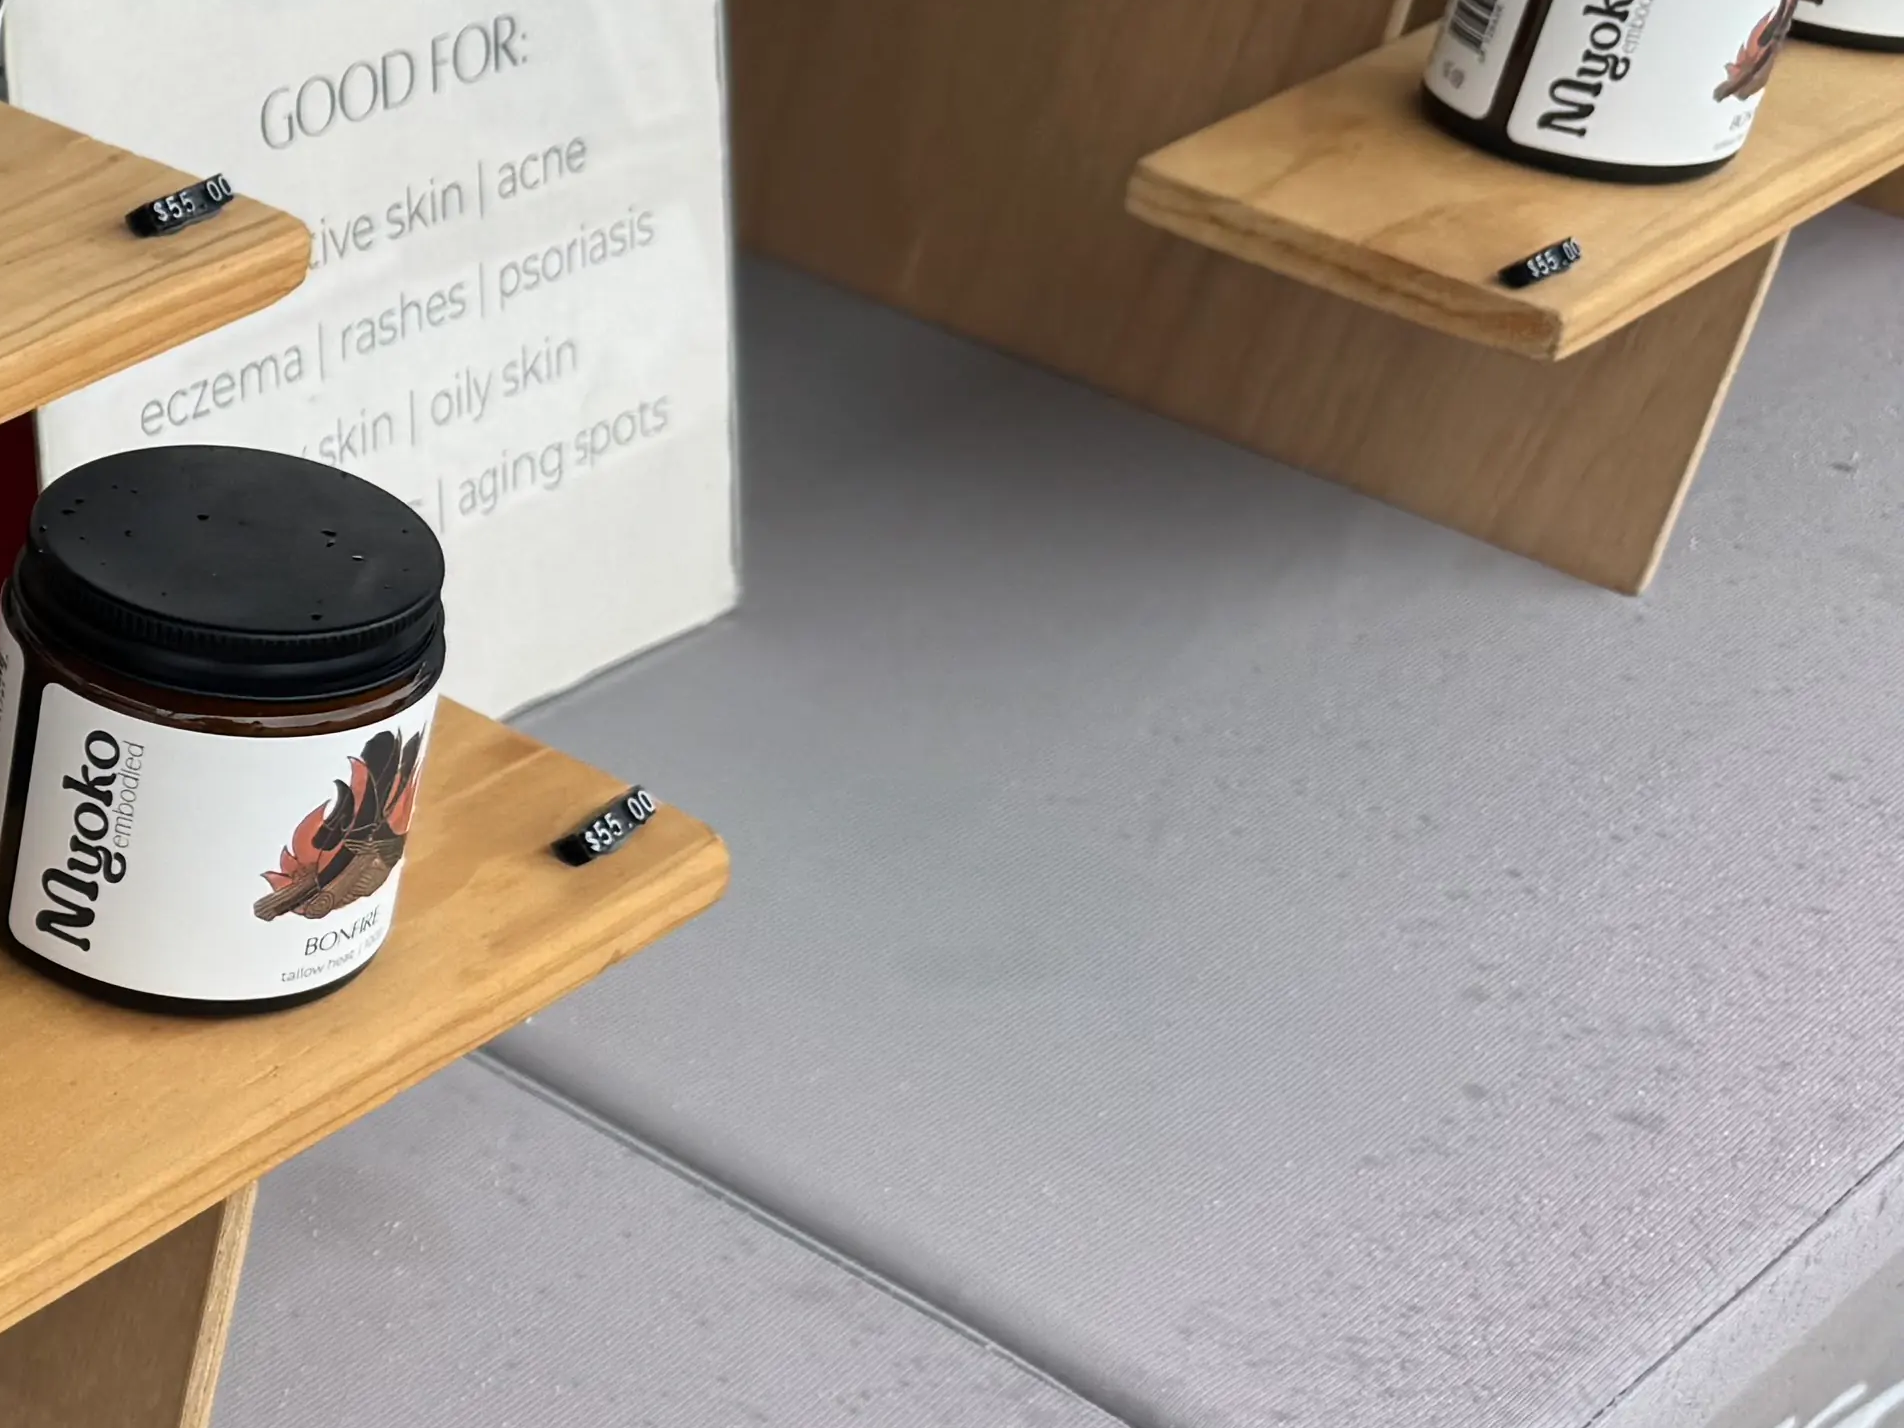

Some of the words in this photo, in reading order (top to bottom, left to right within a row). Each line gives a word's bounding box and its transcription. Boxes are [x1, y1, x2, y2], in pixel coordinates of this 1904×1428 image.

[260, 47, 415, 150] GOOD
[431, 13, 529, 95] FOR:
[386, 178, 465, 240] skin
[497, 136, 588, 200] acne
[140, 343, 304, 438] eczema
[339, 278, 467, 361] rashes
[498, 206, 656, 312] psoriasis
[318, 407, 394, 467] skin
[430, 367, 493, 428] oily
[502, 336, 579, 399] skin
[457, 440, 566, 516] aging
[574, 393, 671, 468] spots
[36, 729, 126, 952] Myoko
[112, 741, 145, 849] embodied
[585, 790, 656, 851] $55.00
